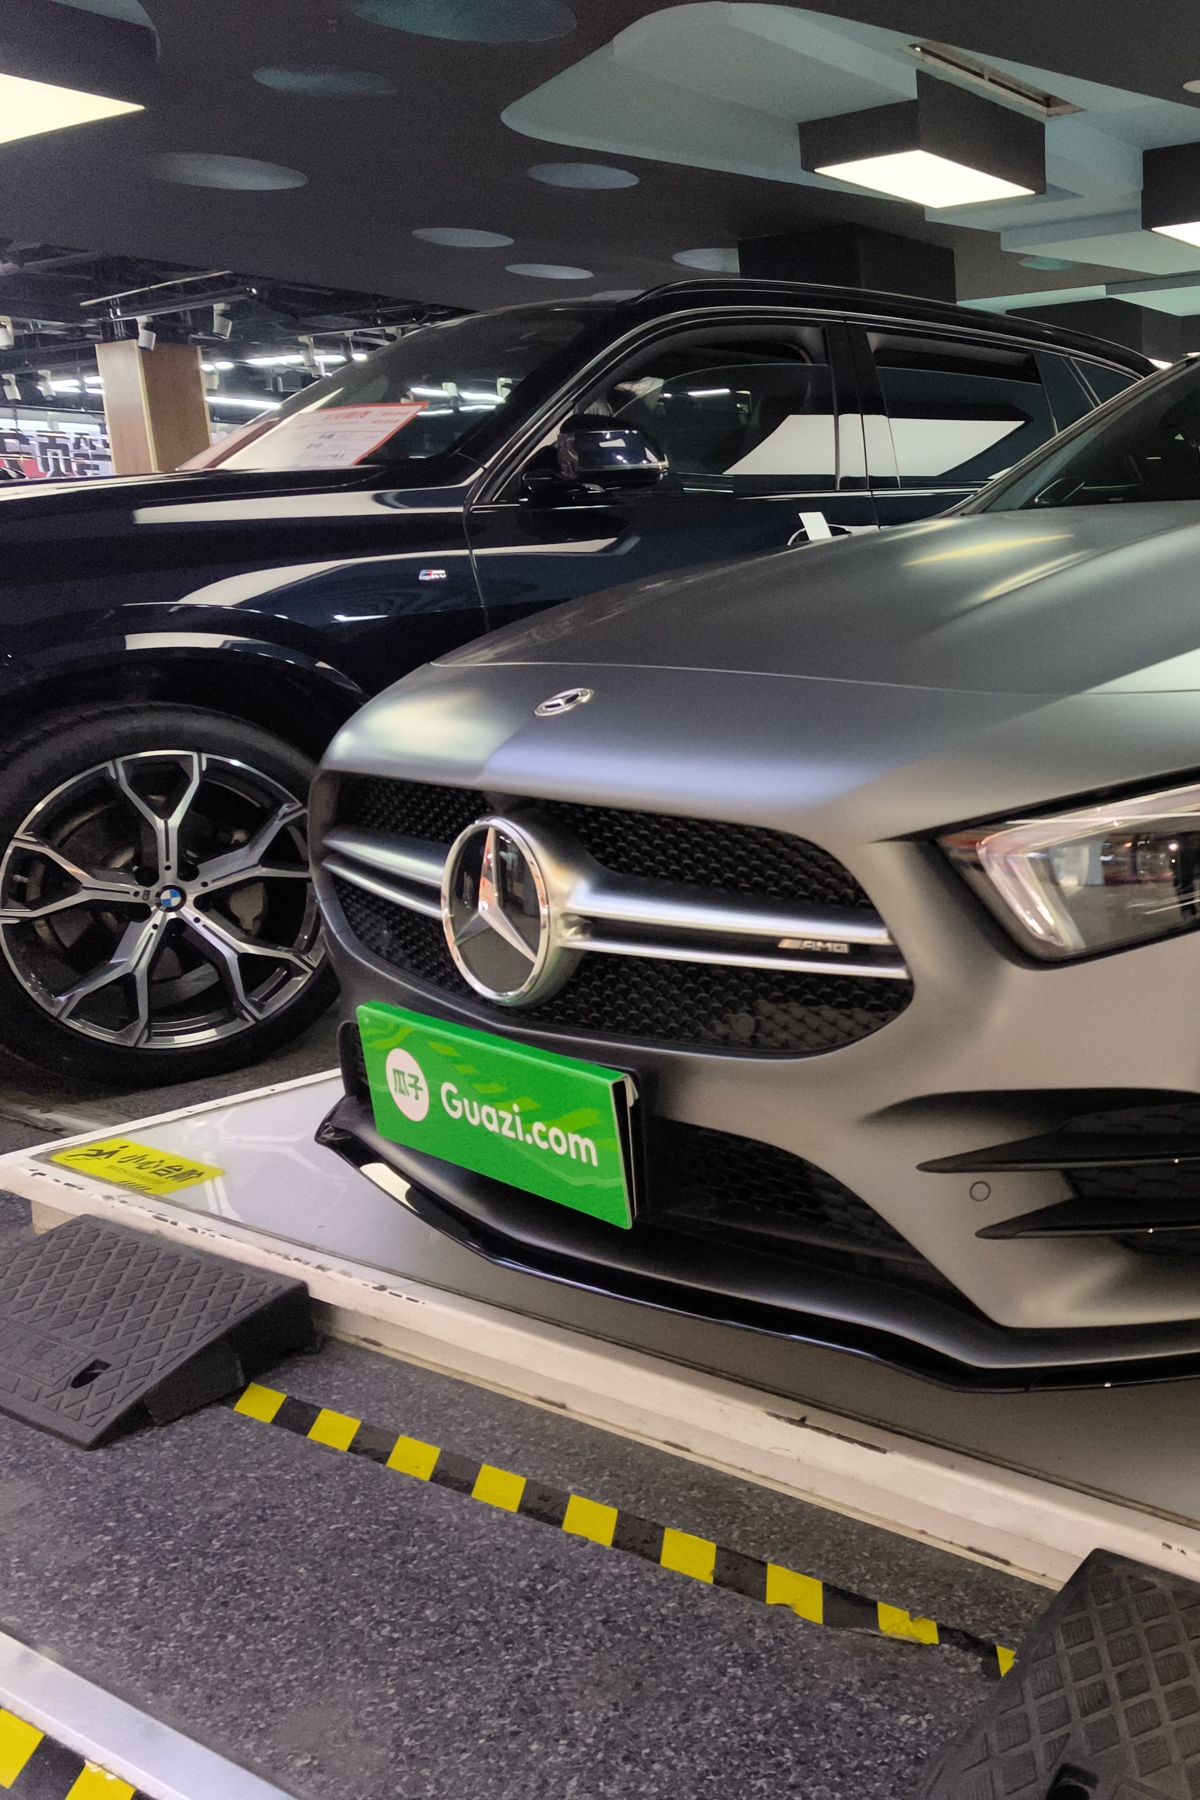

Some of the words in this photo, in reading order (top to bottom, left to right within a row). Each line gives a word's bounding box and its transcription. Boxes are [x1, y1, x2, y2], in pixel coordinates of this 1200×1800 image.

[801, 940, 849, 953] AMG
[391, 1067, 424, 1101] 瓜子
[440, 1081, 599, 1168] Guazi.com
